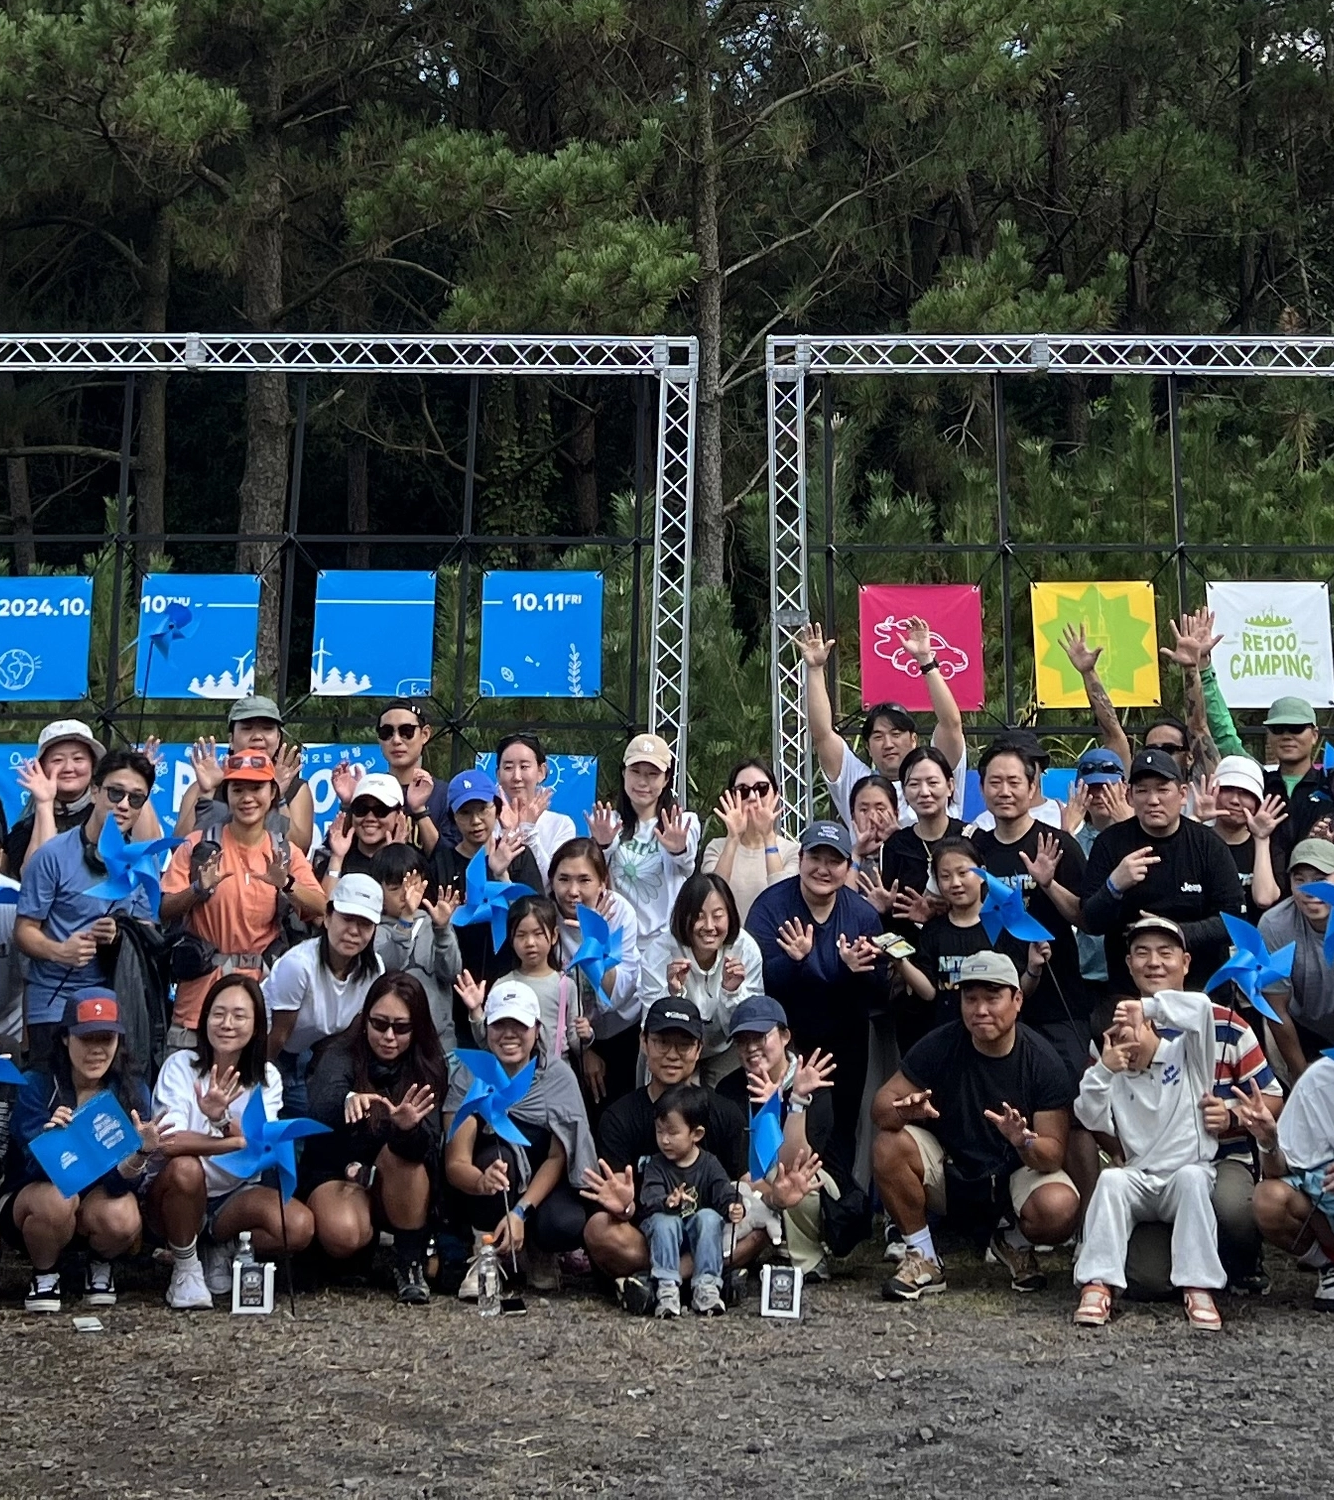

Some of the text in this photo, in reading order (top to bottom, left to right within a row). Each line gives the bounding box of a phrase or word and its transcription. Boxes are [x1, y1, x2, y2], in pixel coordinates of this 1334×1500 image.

[1242, 632, 1297, 652] RE100
[1230, 653, 1313, 681] CAMPING
[1180, 882, 1203, 894] Jeep
